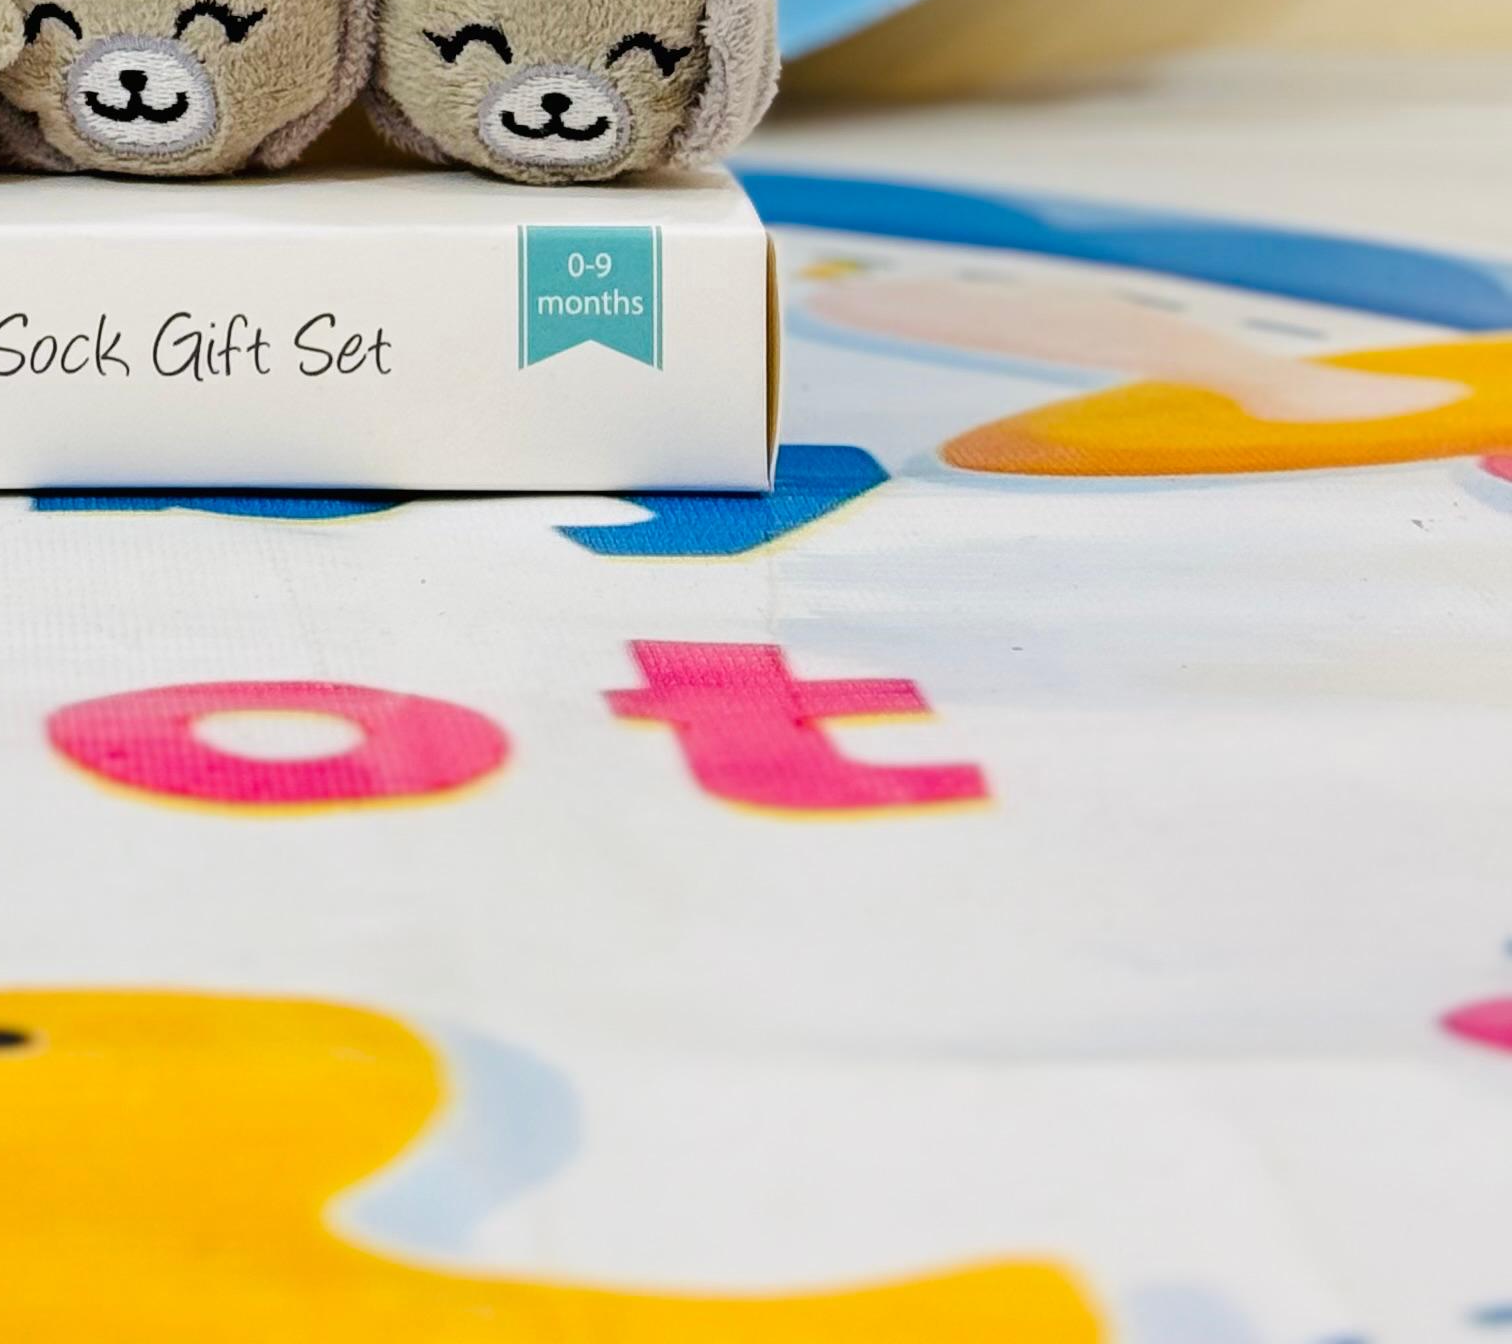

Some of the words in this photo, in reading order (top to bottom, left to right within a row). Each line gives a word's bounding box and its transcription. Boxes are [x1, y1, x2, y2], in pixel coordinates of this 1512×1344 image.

[567, 252, 613, 279] 0-9
[537, 288, 645, 316] months
[152, 311, 271, 383] Gift
[293, 312, 392, 377] Set
